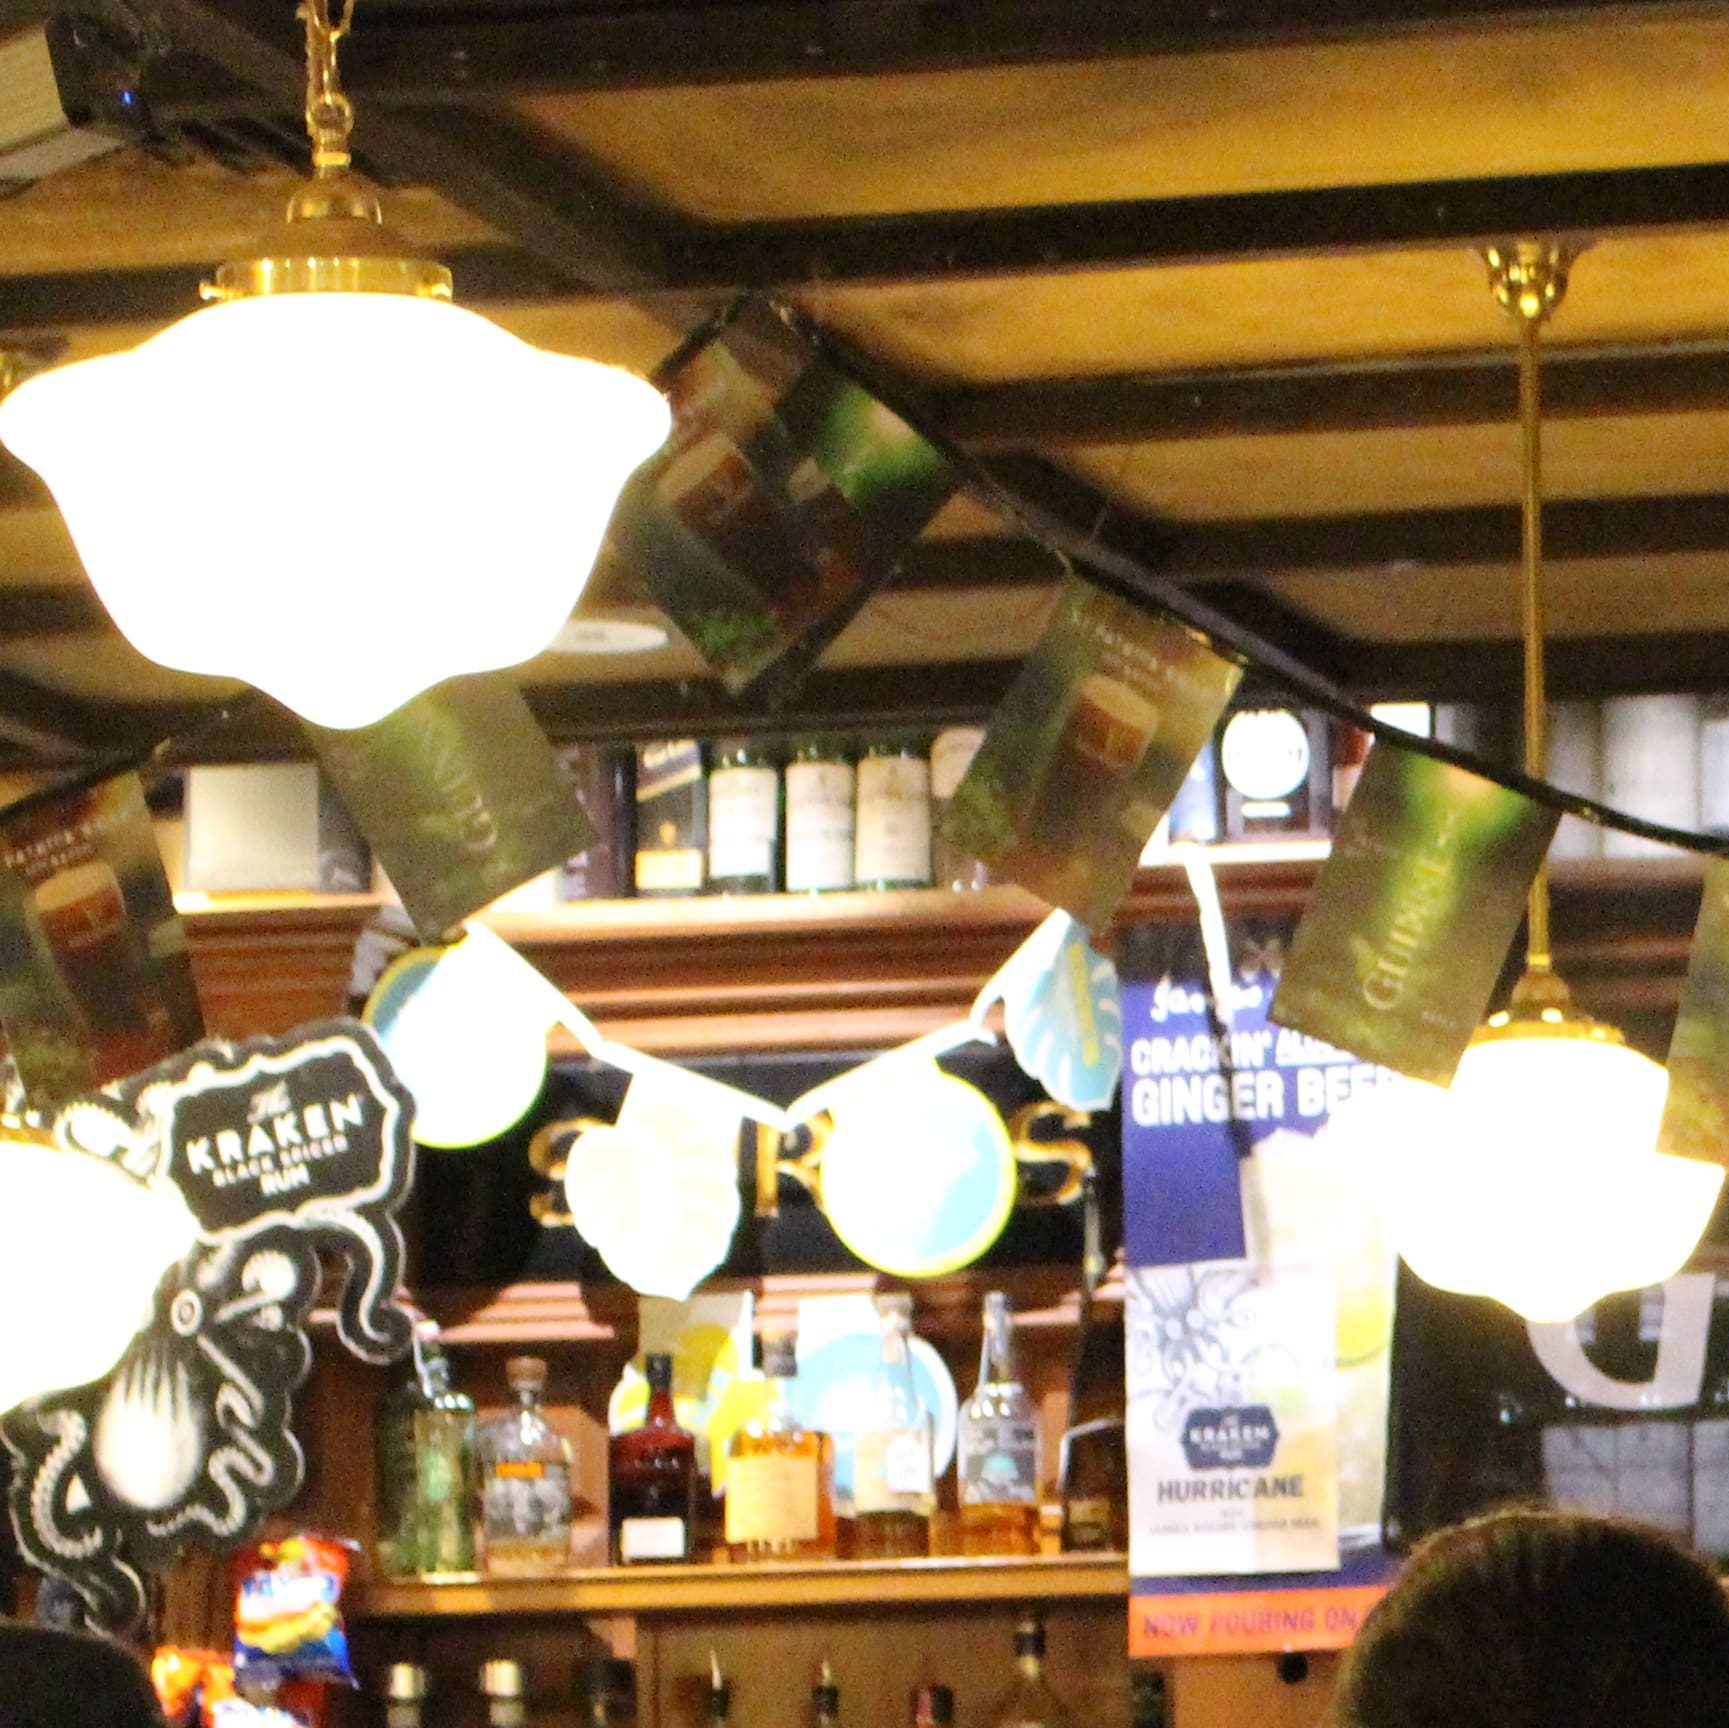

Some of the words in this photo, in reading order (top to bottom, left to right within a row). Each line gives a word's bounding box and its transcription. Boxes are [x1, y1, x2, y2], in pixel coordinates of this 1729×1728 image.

[1132, 1069, 1285, 1127] GINGER
[186, 1092, 363, 1174] KRAKEN
[260, 1161, 311, 1196] RUM
[1145, 1614, 1199, 1638] NOW
[1209, 1607, 1316, 1635] POURING
